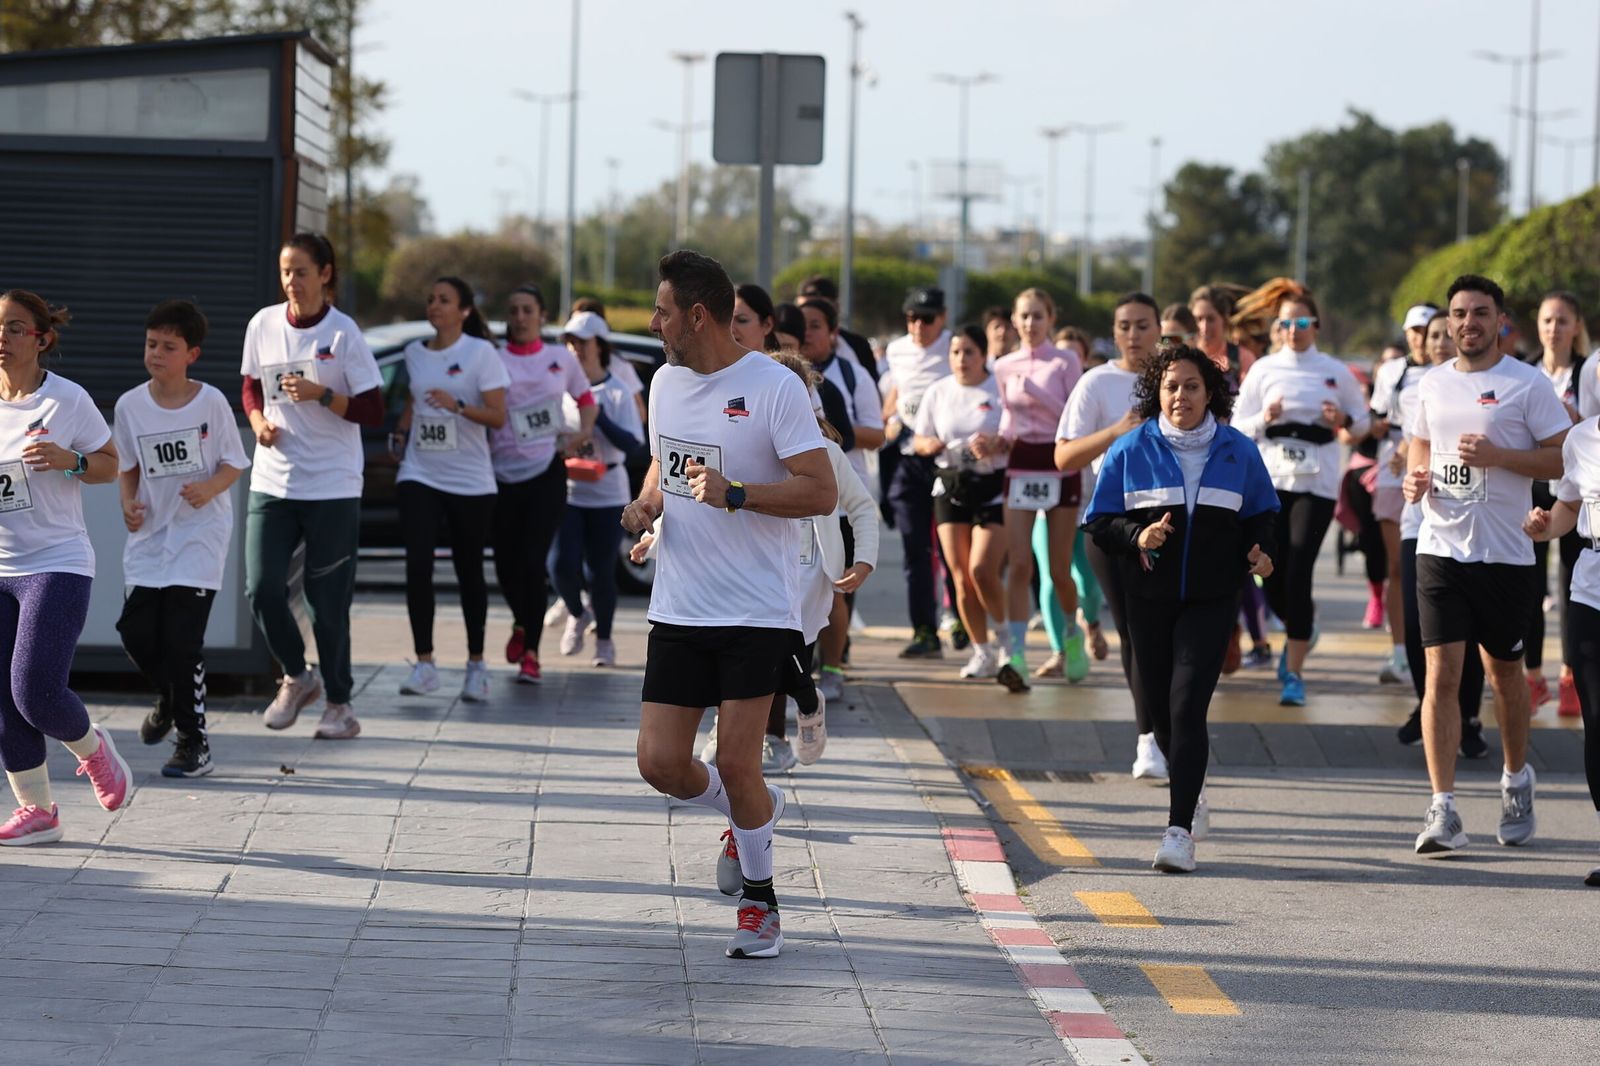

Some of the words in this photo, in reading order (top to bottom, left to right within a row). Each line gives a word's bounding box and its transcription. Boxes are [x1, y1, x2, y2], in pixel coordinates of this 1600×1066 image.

[525, 409, 551, 429] 138
[153, 440, 188, 464] 106
[1442, 464, 1471, 485] 189
[0, 474, 15, 498] 2
